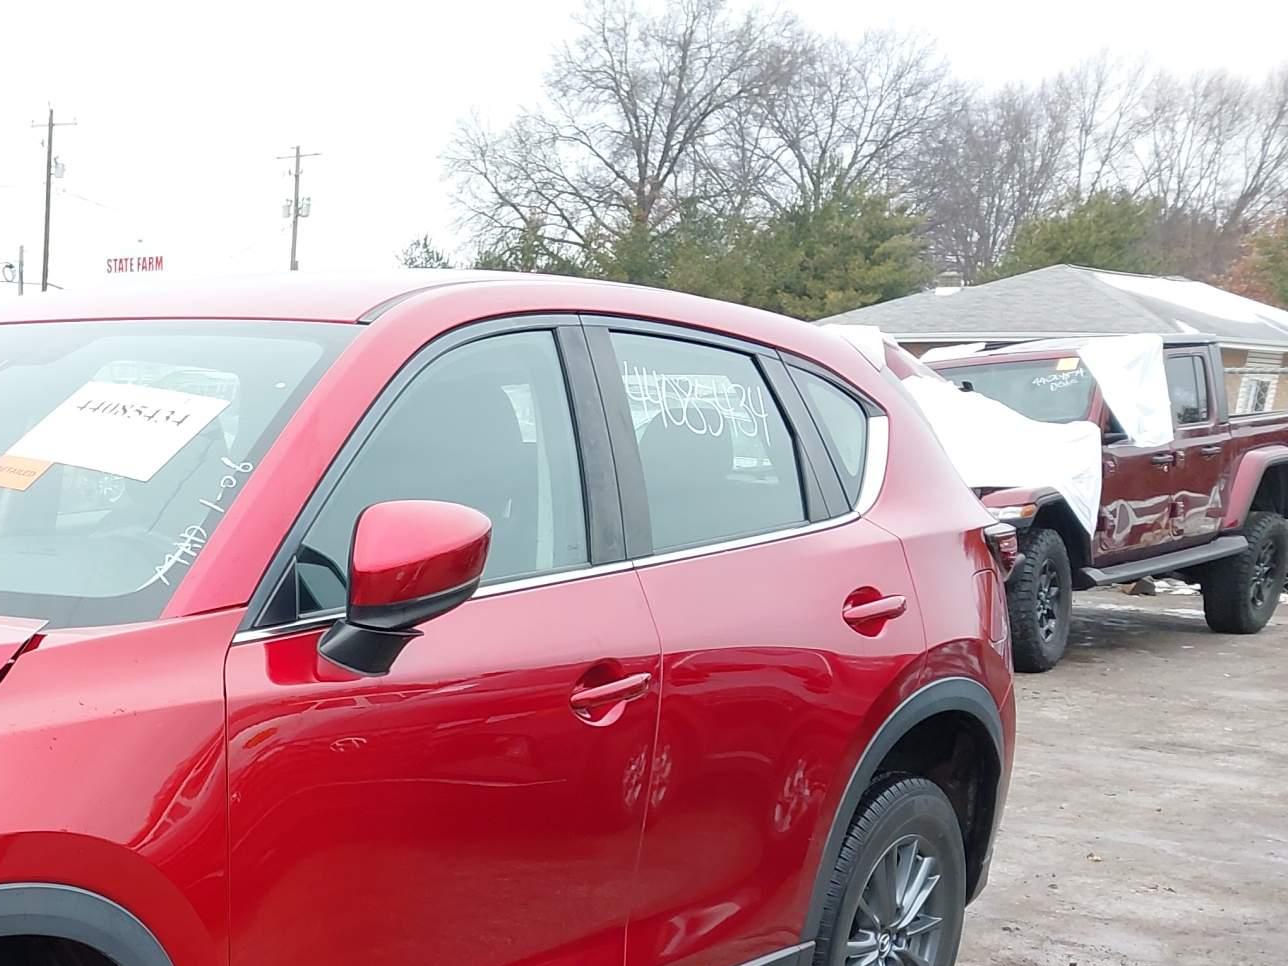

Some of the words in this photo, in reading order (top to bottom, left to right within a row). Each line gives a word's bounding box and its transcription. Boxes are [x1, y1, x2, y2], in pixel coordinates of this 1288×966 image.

[106, 258, 134, 274] STATE
[137, 256, 164, 272] FARM
[77, 399, 190, 426] 44085434
[624, 361, 771, 447] 44085434
